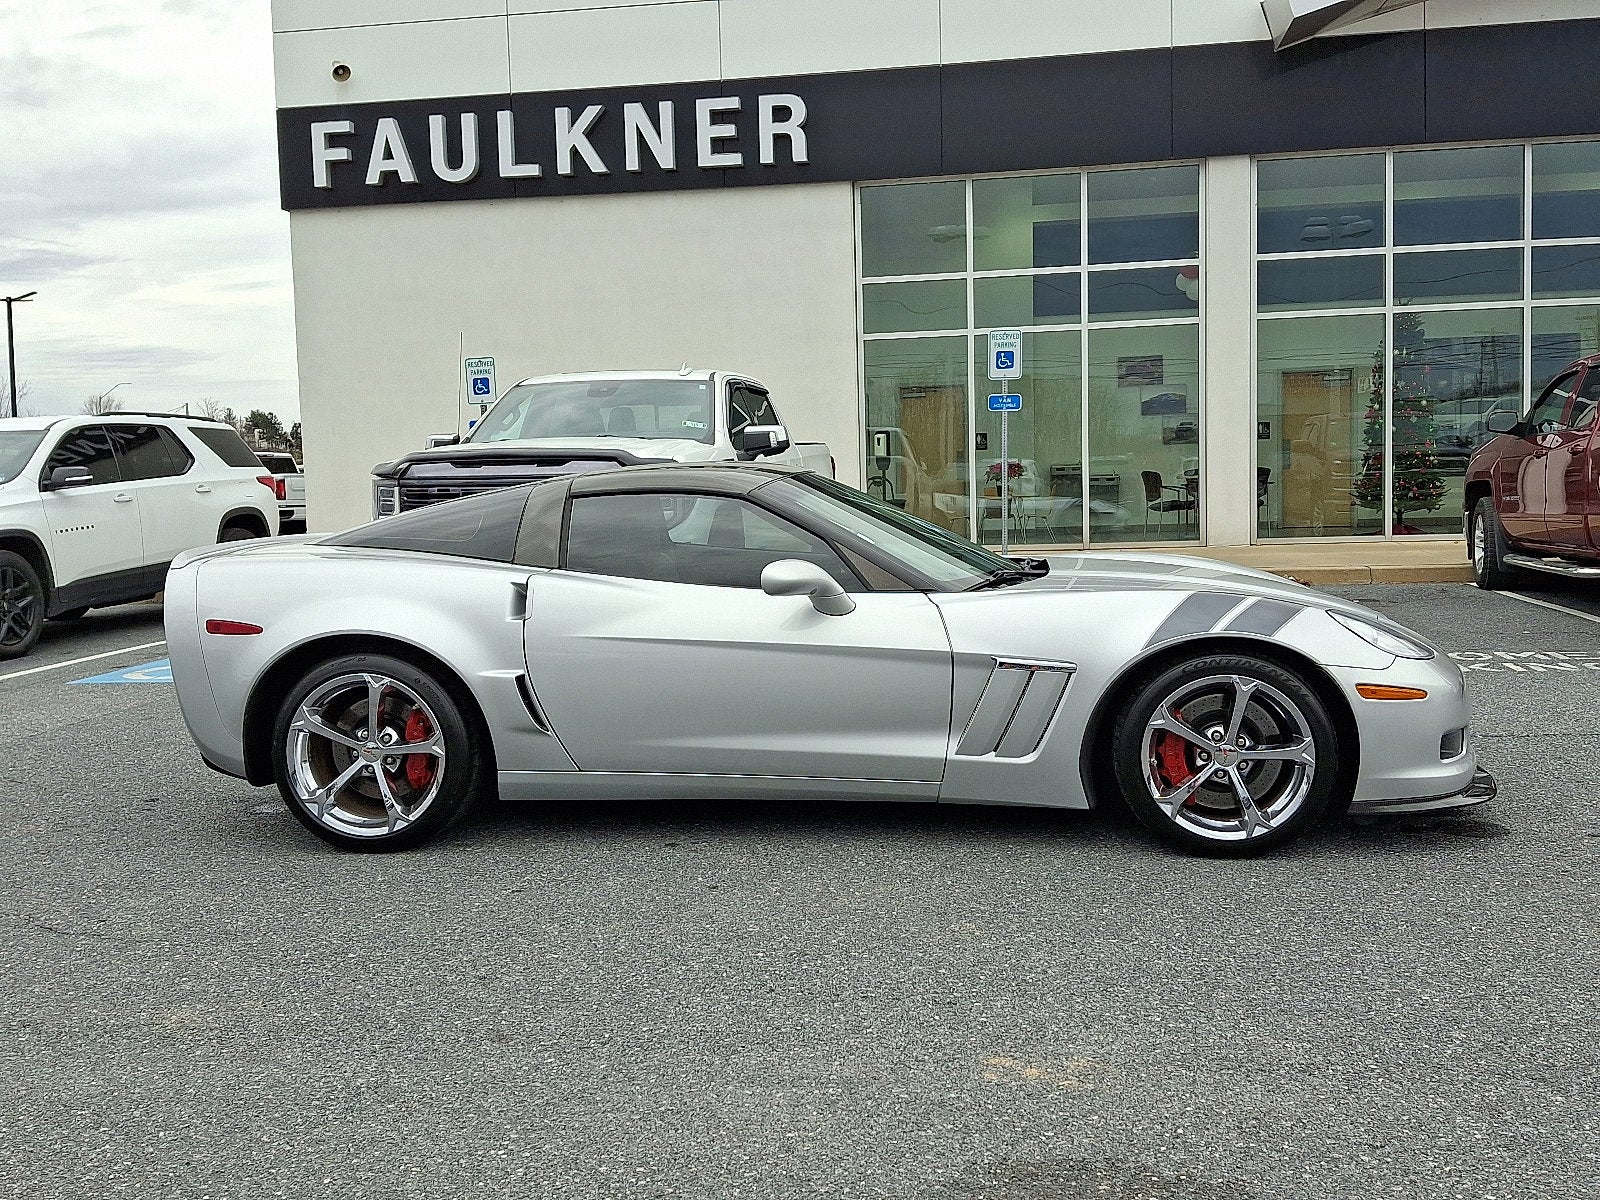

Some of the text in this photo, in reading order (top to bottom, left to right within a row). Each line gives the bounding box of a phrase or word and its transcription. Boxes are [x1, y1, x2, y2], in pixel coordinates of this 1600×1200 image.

[310, 93, 809, 189] FAULKNER
[990, 333, 1020, 341] RESERVED
[467, 360, 494, 368] RESERVED
[1447, 651, 1600, 660] OME
